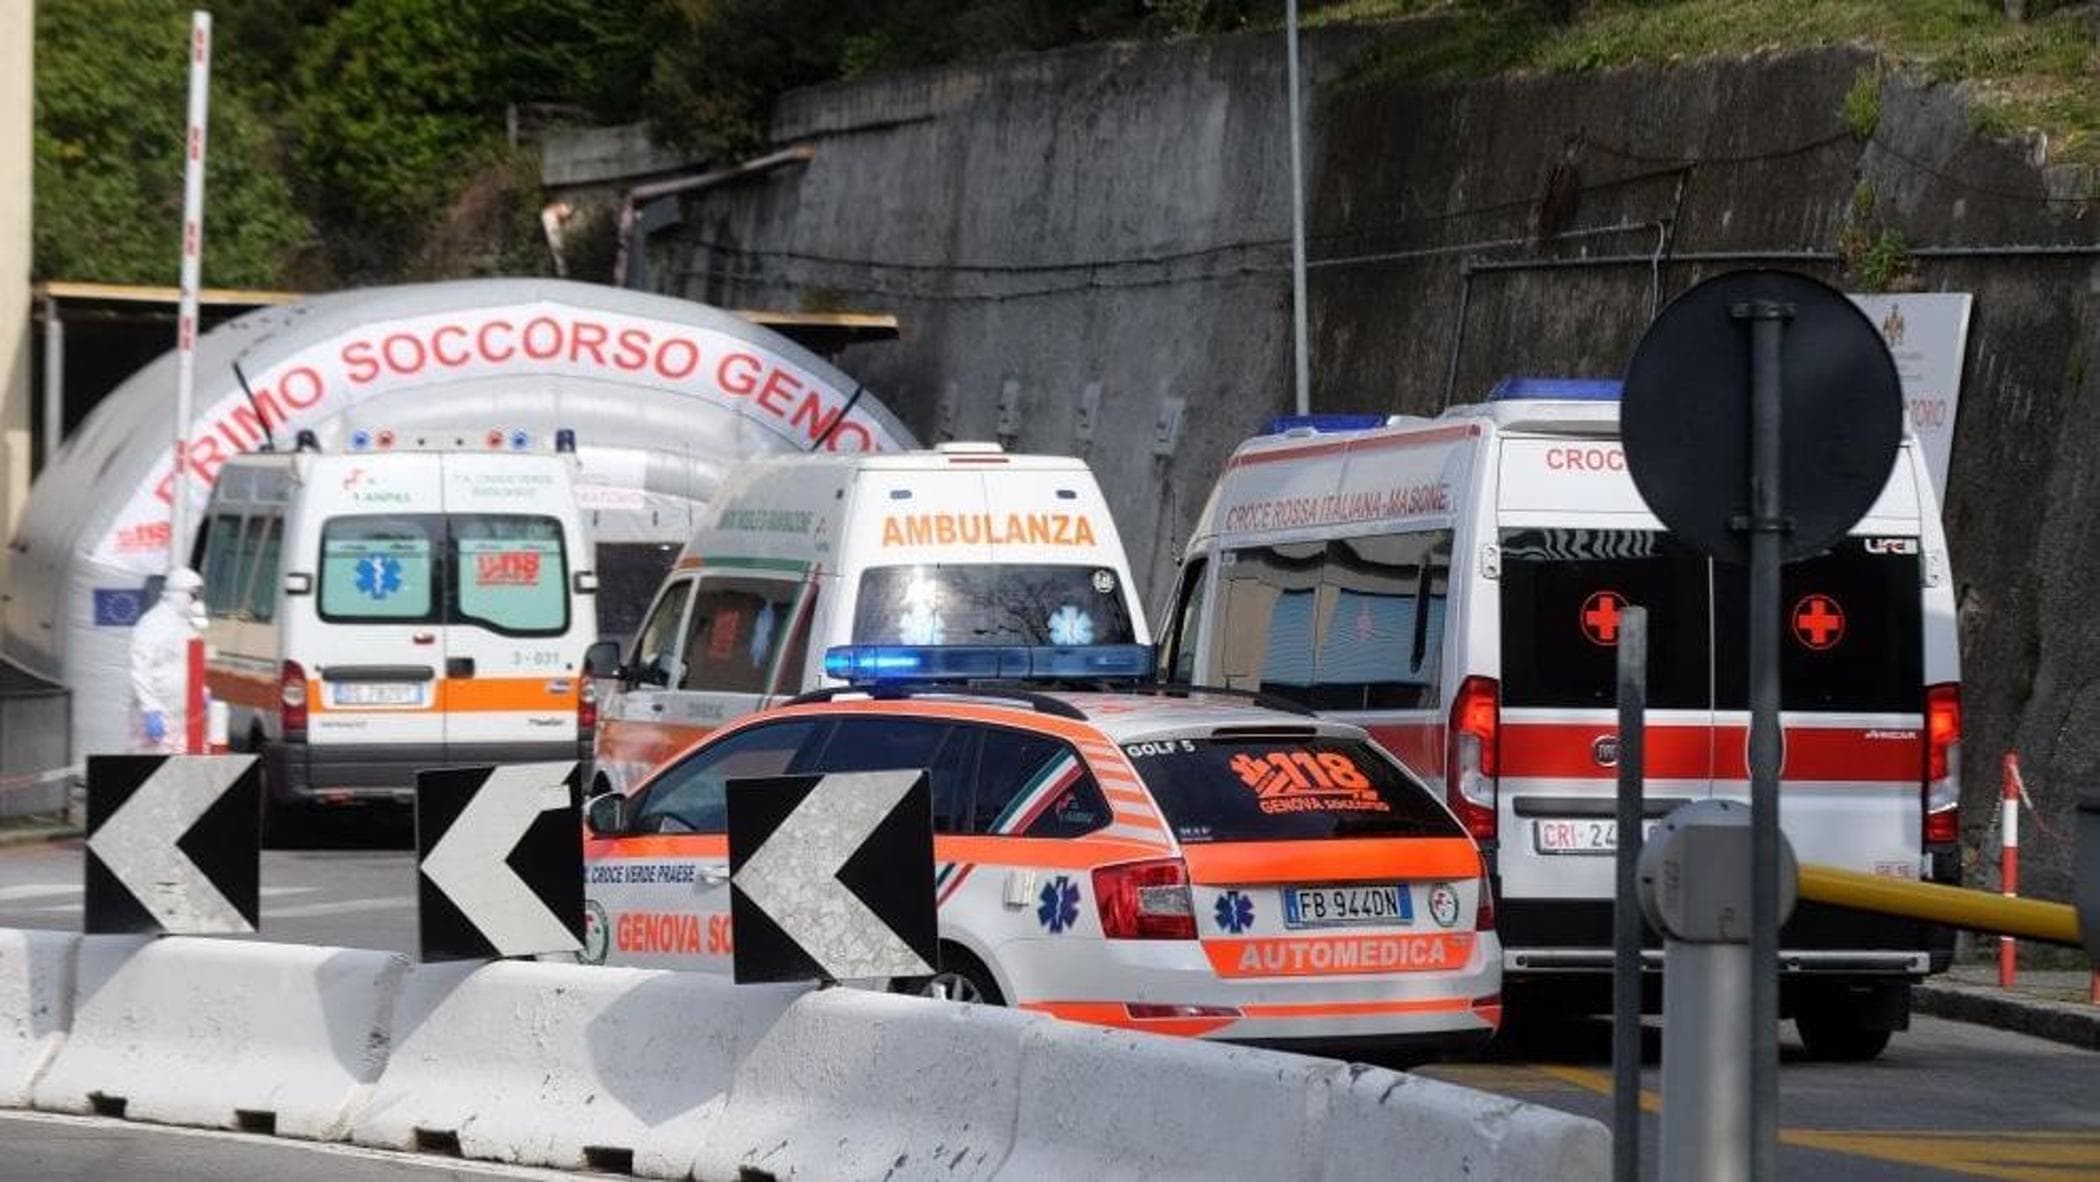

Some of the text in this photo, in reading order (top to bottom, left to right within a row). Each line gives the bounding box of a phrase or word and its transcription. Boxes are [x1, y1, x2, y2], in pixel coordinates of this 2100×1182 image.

[340, 316, 700, 384] SOCCORSO
[716, 351, 884, 453] GENO
[1547, 449, 1626, 471] CROC
[881, 512, 1097, 547] AMBULANZA
[1226, 502, 1272, 531] CROCE
[1271, 498, 1319, 527] ROSSA
[1127, 740, 1196, 758] GOLF 5
[1266, 752, 1371, 790] 118
[1260, 797, 1323, 814] GENOVA
[591, 865, 624, 883] CROCE
[625, 865, 656, 883] VERDE
[656, 865, 695, 883] PRAESE
[1301, 885, 1400, 919] FB 944DN
[617, 913, 700, 953] GENOVA
[1238, 936, 1447, 971] AUTOMEDICA
